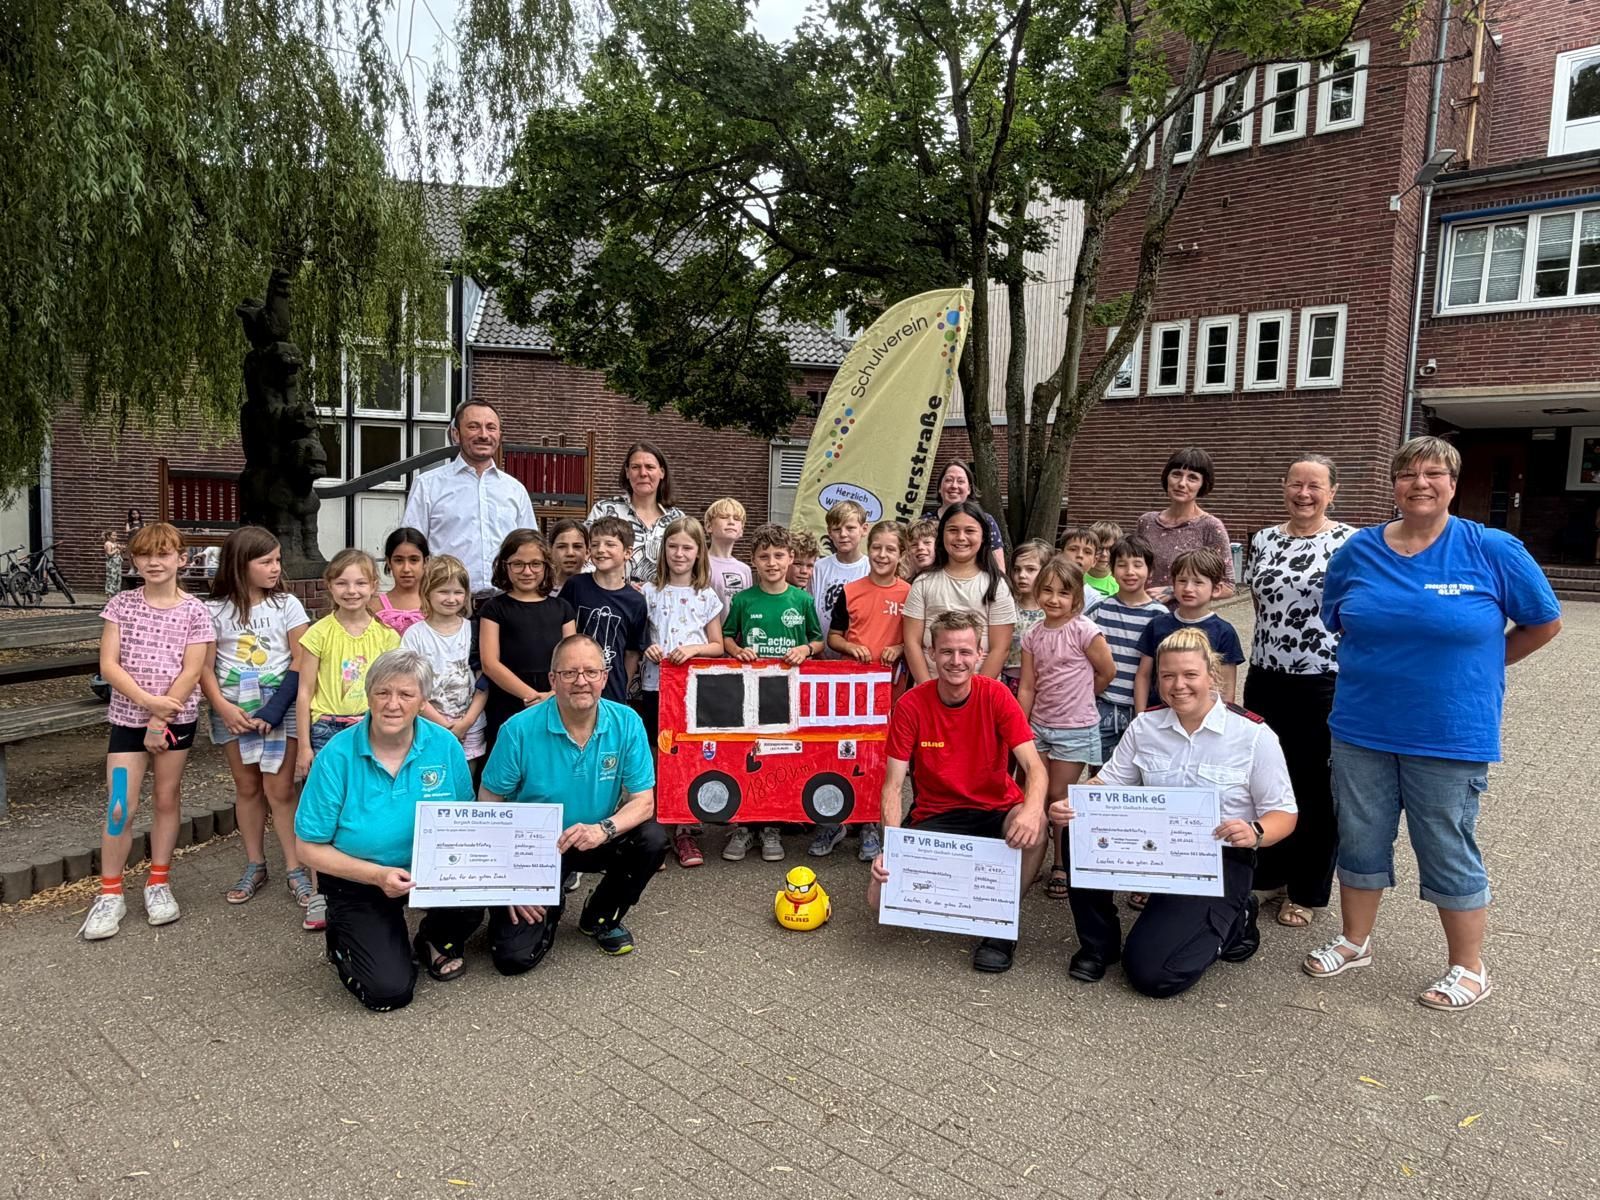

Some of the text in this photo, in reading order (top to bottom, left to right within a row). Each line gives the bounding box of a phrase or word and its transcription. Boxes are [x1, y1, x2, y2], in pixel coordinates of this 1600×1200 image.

[850, 316, 929, 398] Schulverein
[836, 486, 869, 503] Herzlich
[767, 636, 796, 647] action
[1105, 792, 1166, 805] VR Bank eG
[454, 808, 513, 819] VR Bank eG
[918, 836, 974, 852] VR Bank eG
